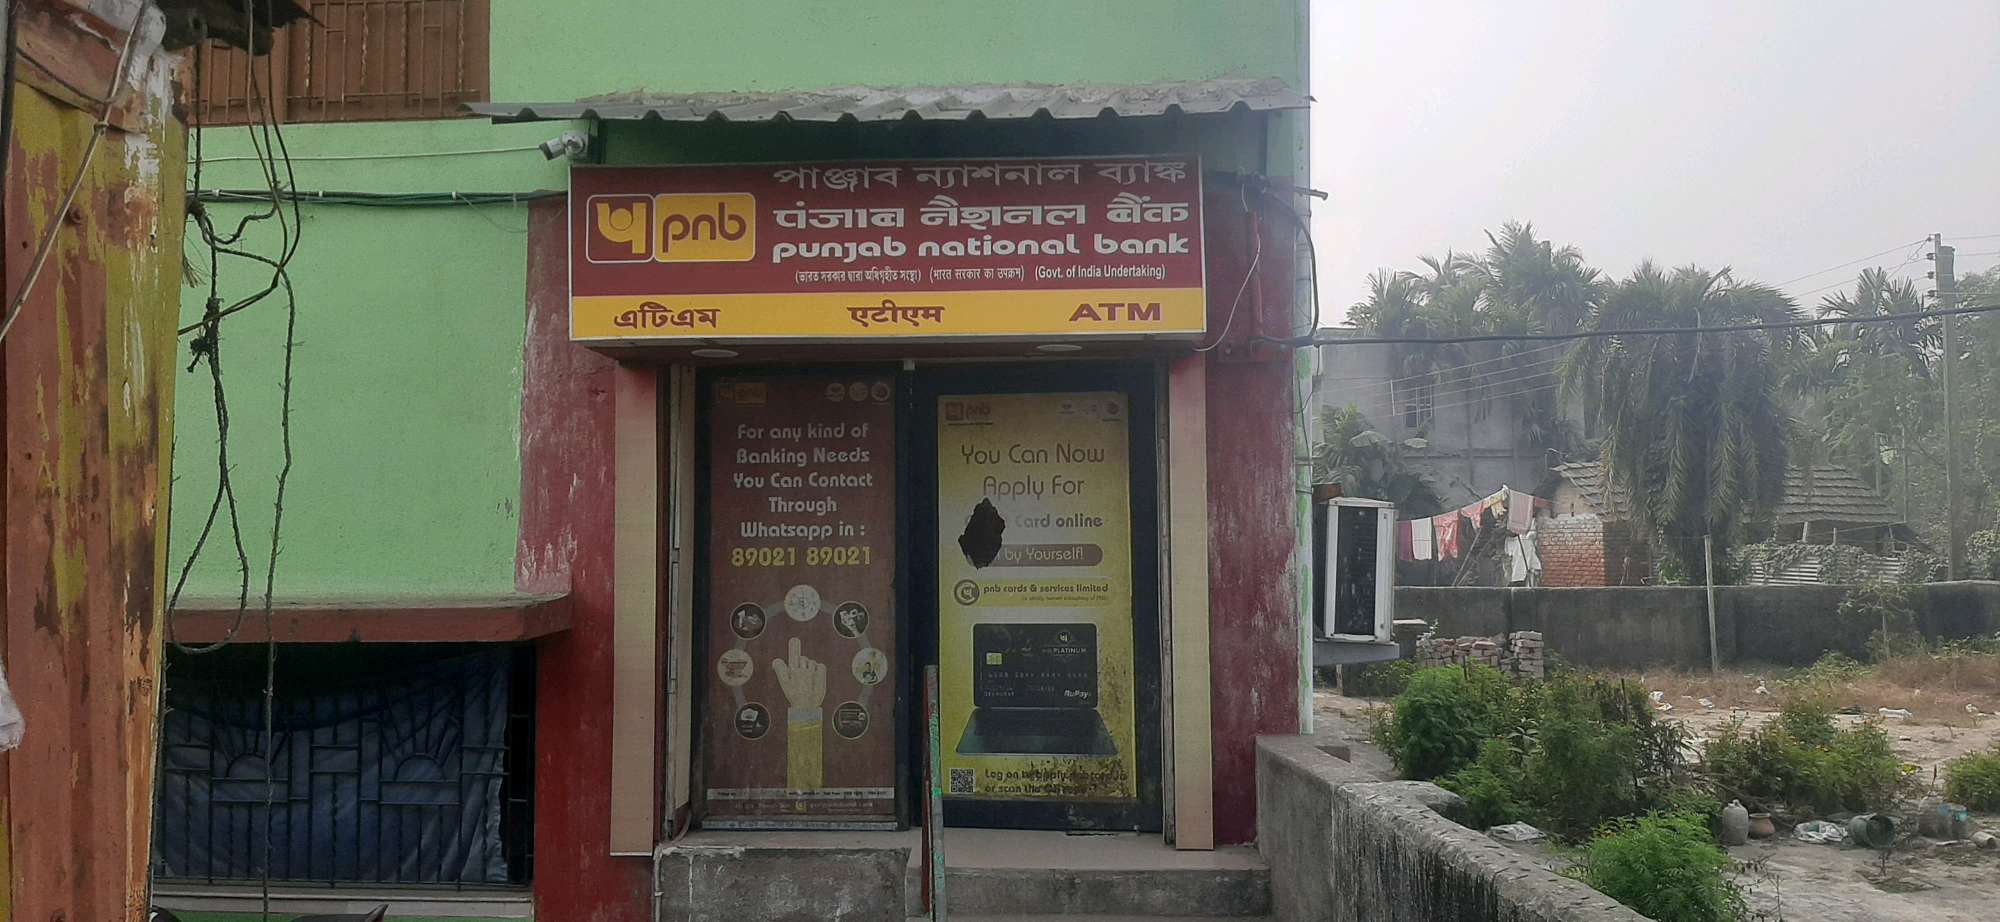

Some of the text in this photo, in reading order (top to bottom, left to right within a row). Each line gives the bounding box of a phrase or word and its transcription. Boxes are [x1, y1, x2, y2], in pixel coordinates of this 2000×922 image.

[773, 160, 1187, 192] পাঞ্জাব ন্যাশনাল ব্যাঙ্ক
[772, 200, 905, 229] पंजाब
[1106, 191, 1189, 224] बैंक
[662, 202, 747, 253] pnb
[772, 232, 1189, 264] punjab national bank
[929, 266, 952, 284] (भारत
[954, 268, 981, 280] सरकार
[984, 268, 994, 279] का
[1035, 264, 1166, 280] (Govt. of India Undertaking)
[614, 301, 721, 329] এটিএম
[846, 299, 945, 328] एटीएम
[1068, 303, 1161, 321] ATM
[737, 423, 869, 442] For any kind of
[736, 447, 870, 467] Banking Needs
[961, 443, 1105, 465] You Can Now
[733, 472, 873, 488] You Can Contact
[983, 475, 1085, 500] Apply For
[768, 497, 837, 516] Through
[1015, 513, 1104, 528] Card online
[740, 522, 833, 541] Whatsapp
[839, 521, 854, 537] in
[731, 546, 871, 566] 89021 89021
[1005, 546, 1022, 564] by
[1026, 546, 1085, 560] Yourself!
[983, 582, 1109, 594] pnb cards & services limited
[985, 769, 1003, 781] Log
[1006, 771, 1019, 779] on
[985, 785, 995, 793] or
